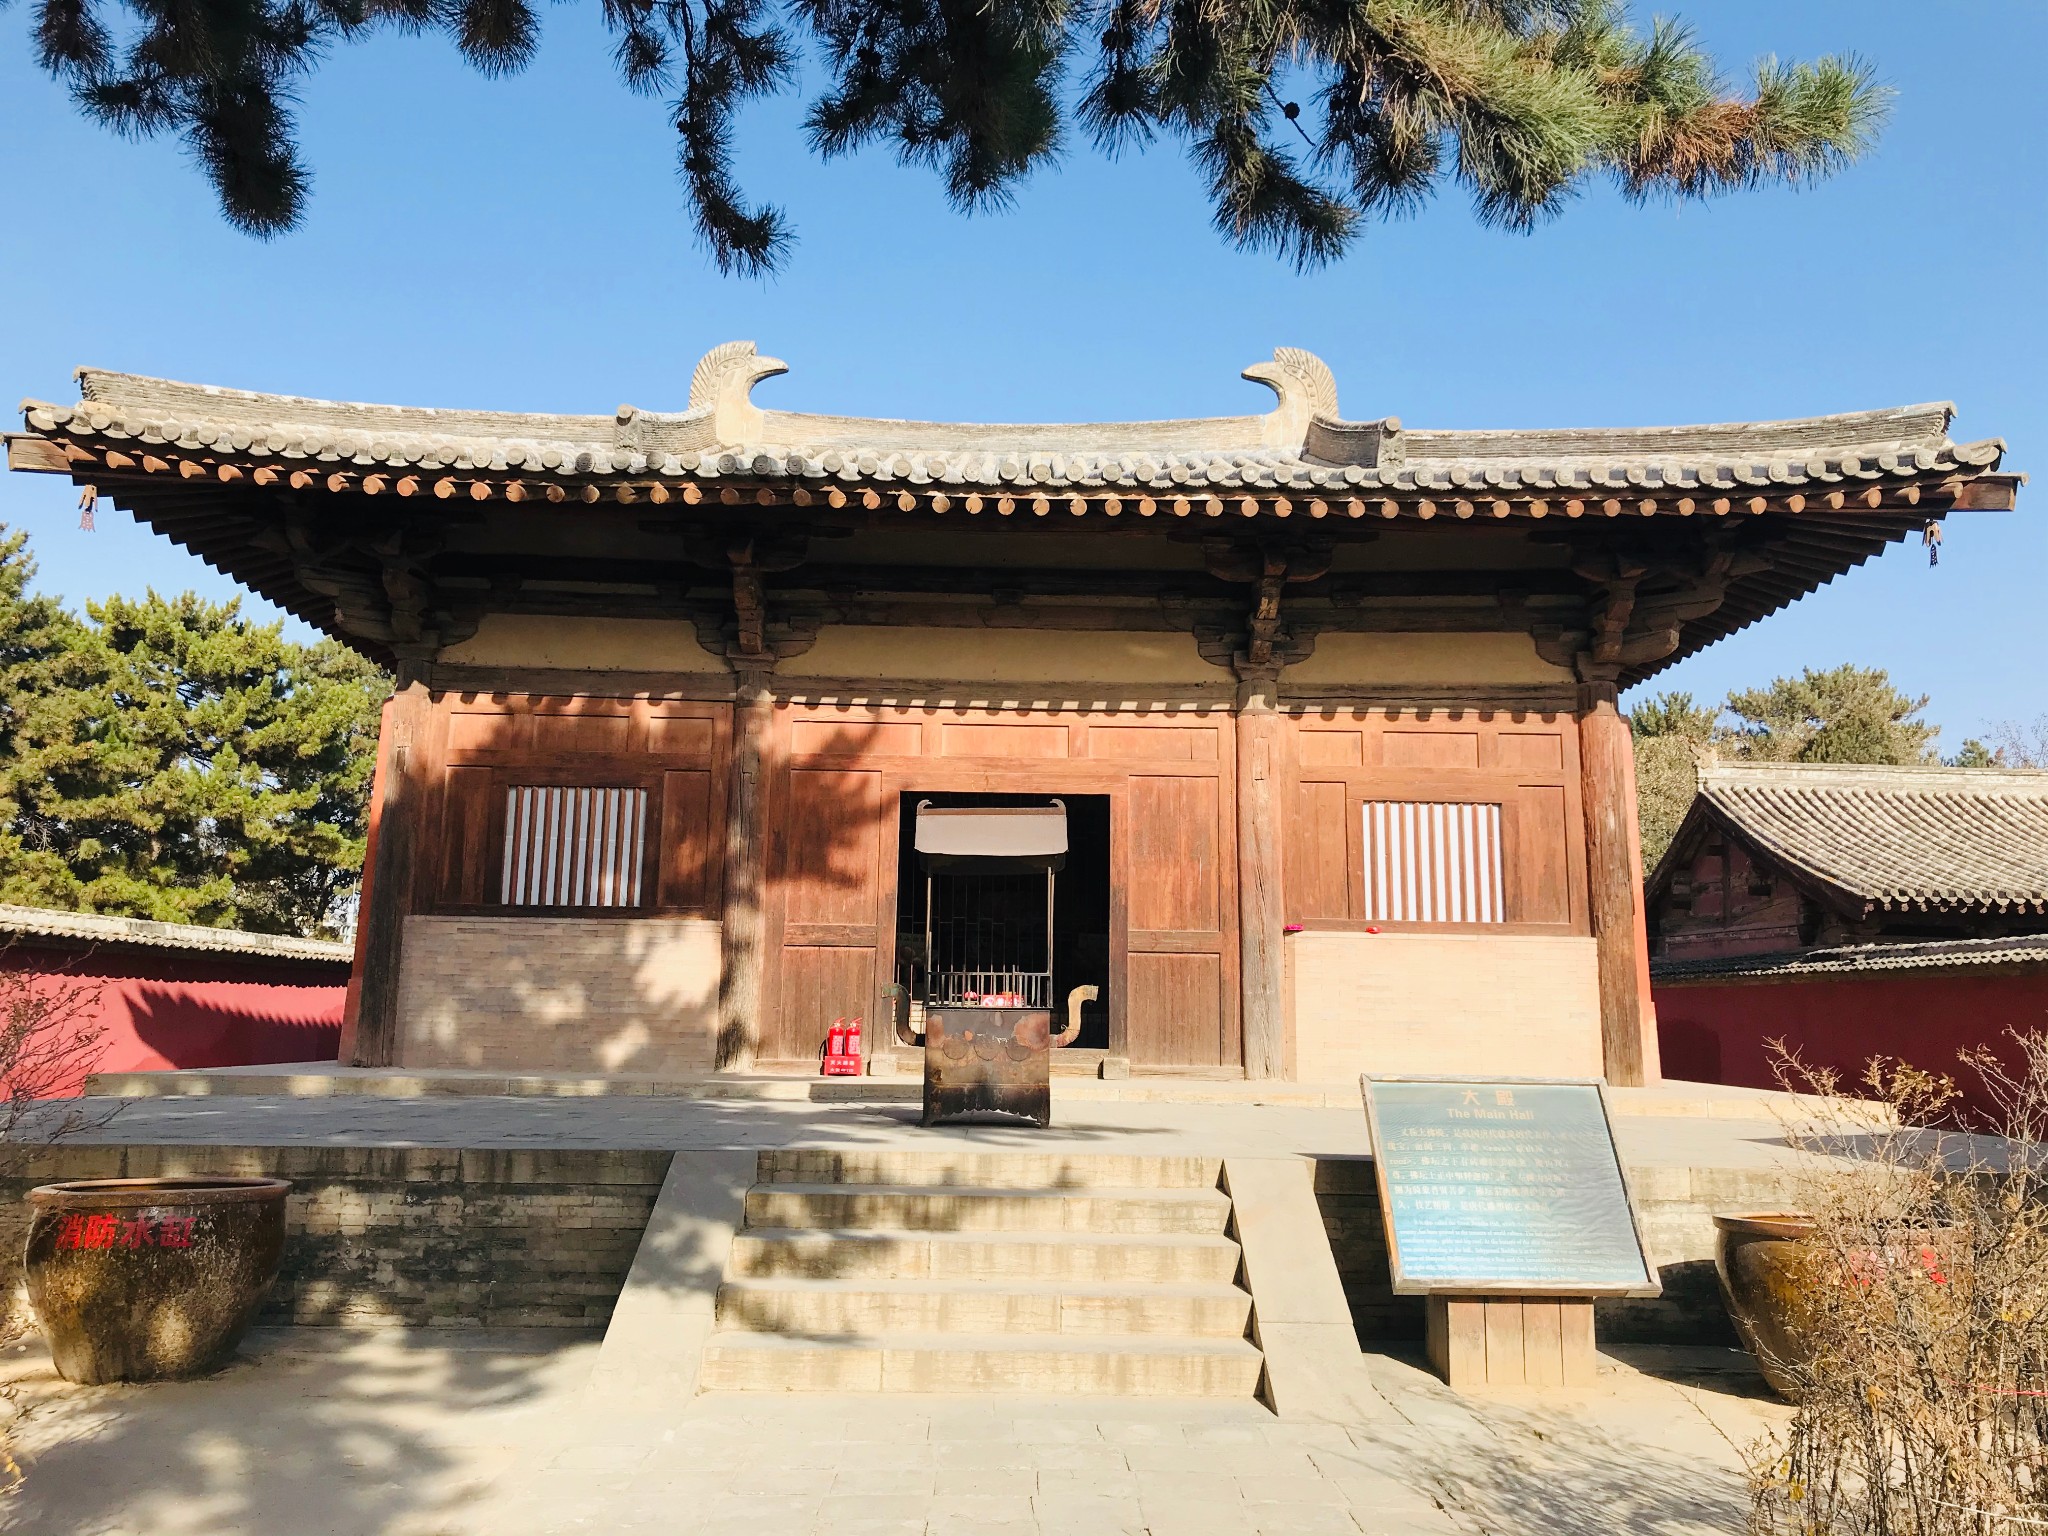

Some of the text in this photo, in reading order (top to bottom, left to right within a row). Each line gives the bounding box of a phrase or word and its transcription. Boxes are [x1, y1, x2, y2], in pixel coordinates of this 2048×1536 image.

[1461, 1090, 1515, 1106] 大殿
[1447, 1108, 1535, 1121] The Main Hall
[55, 1213, 198, 1250] 消防水缸
